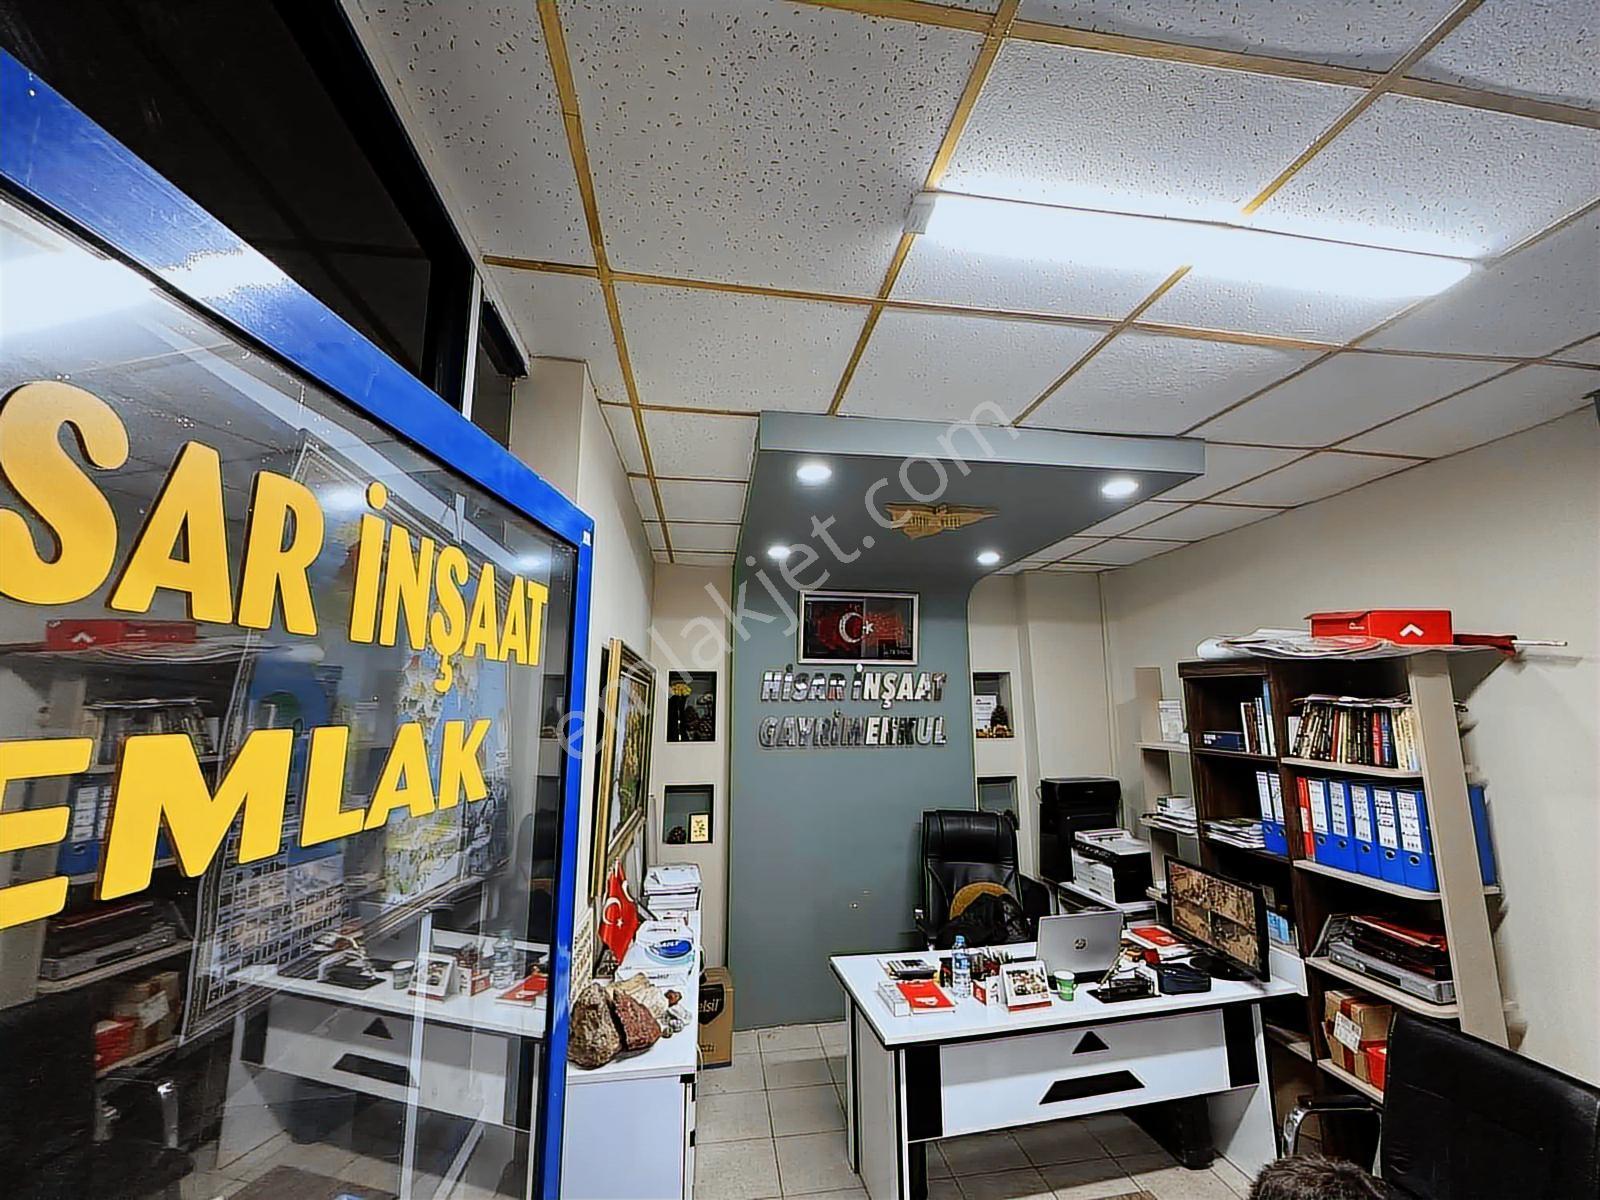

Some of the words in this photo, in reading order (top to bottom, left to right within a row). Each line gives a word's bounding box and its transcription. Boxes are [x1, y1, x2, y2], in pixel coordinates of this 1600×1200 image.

[349, 481, 548, 692] İNŞAAT
[759, 708, 948, 747] GAYRİMENKUL
[760, 663, 847, 701] HİSAR
[851, 663, 947, 709] İNŞAAT
[0, 719, 491, 928] EMLAK
